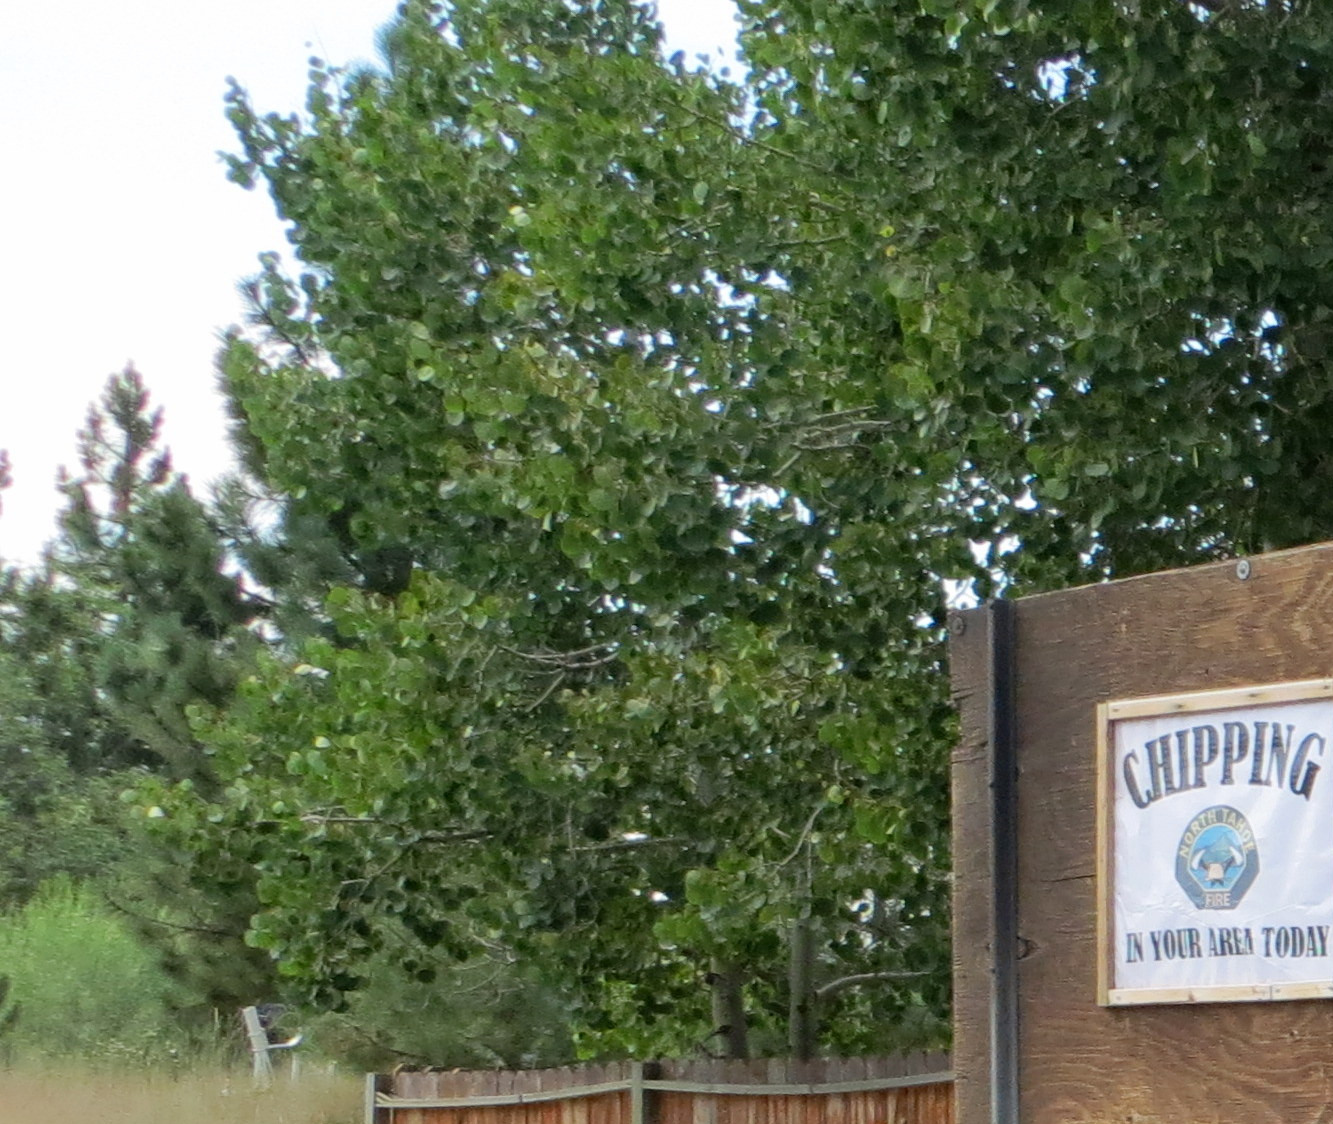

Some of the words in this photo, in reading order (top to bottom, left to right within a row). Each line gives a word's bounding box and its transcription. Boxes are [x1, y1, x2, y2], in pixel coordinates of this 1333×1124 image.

[1123, 721, 1326, 809] CHIPPING
[1180, 809, 1217, 859] NORTH
[1221, 808, 1255, 853] TAHOE
[1205, 893, 1231, 907] FIRE
[1125, 933, 1144, 963] IN
[1149, 927, 1201, 961] YOUR
[1208, 926, 1254, 957] AREA
[1262, 925, 1331, 958] TODAY
